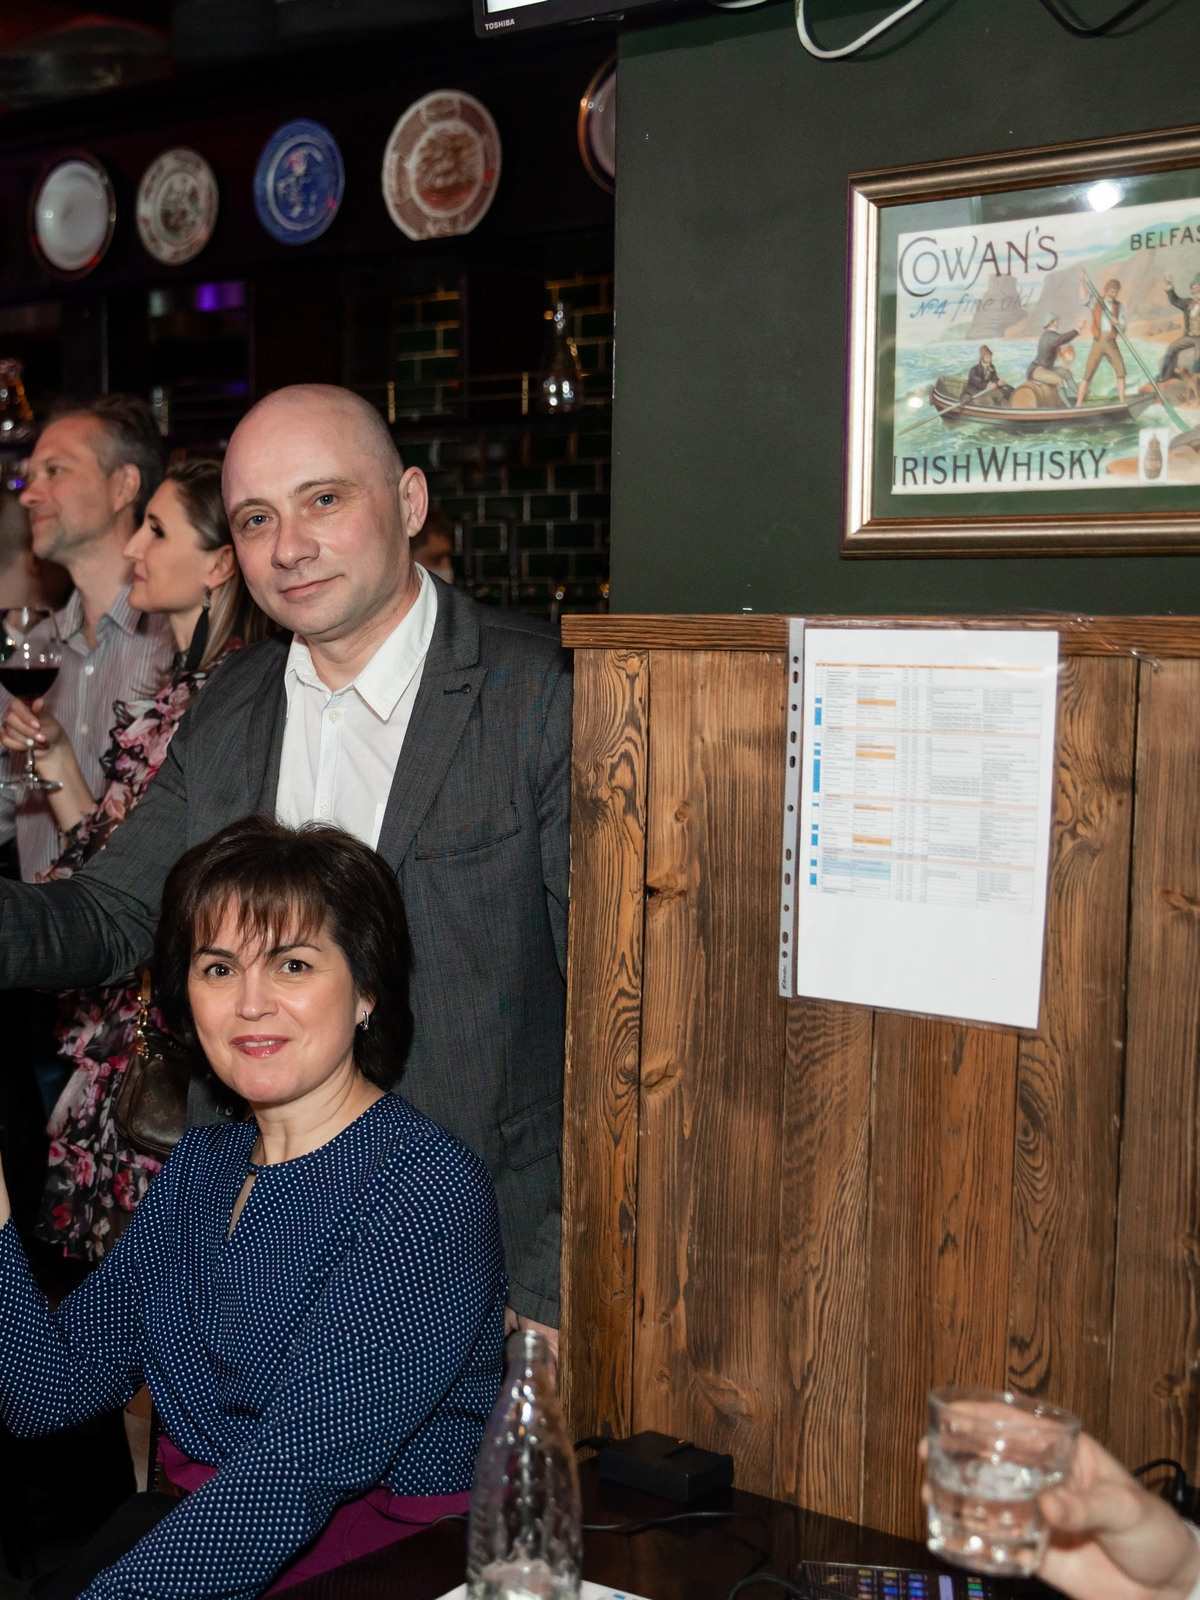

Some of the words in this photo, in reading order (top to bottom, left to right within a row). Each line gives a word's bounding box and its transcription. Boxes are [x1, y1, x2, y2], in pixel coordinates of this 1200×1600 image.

[485, 18, 515, 31] TOSHIBA
[899, 225, 1058, 297] COWAN'S
[951, 293, 993, 322] fine
[1001, 286, 1035, 312] old
[892, 453, 971, 486] IRISH
[976, 446, 1108, 482] WHISKY
